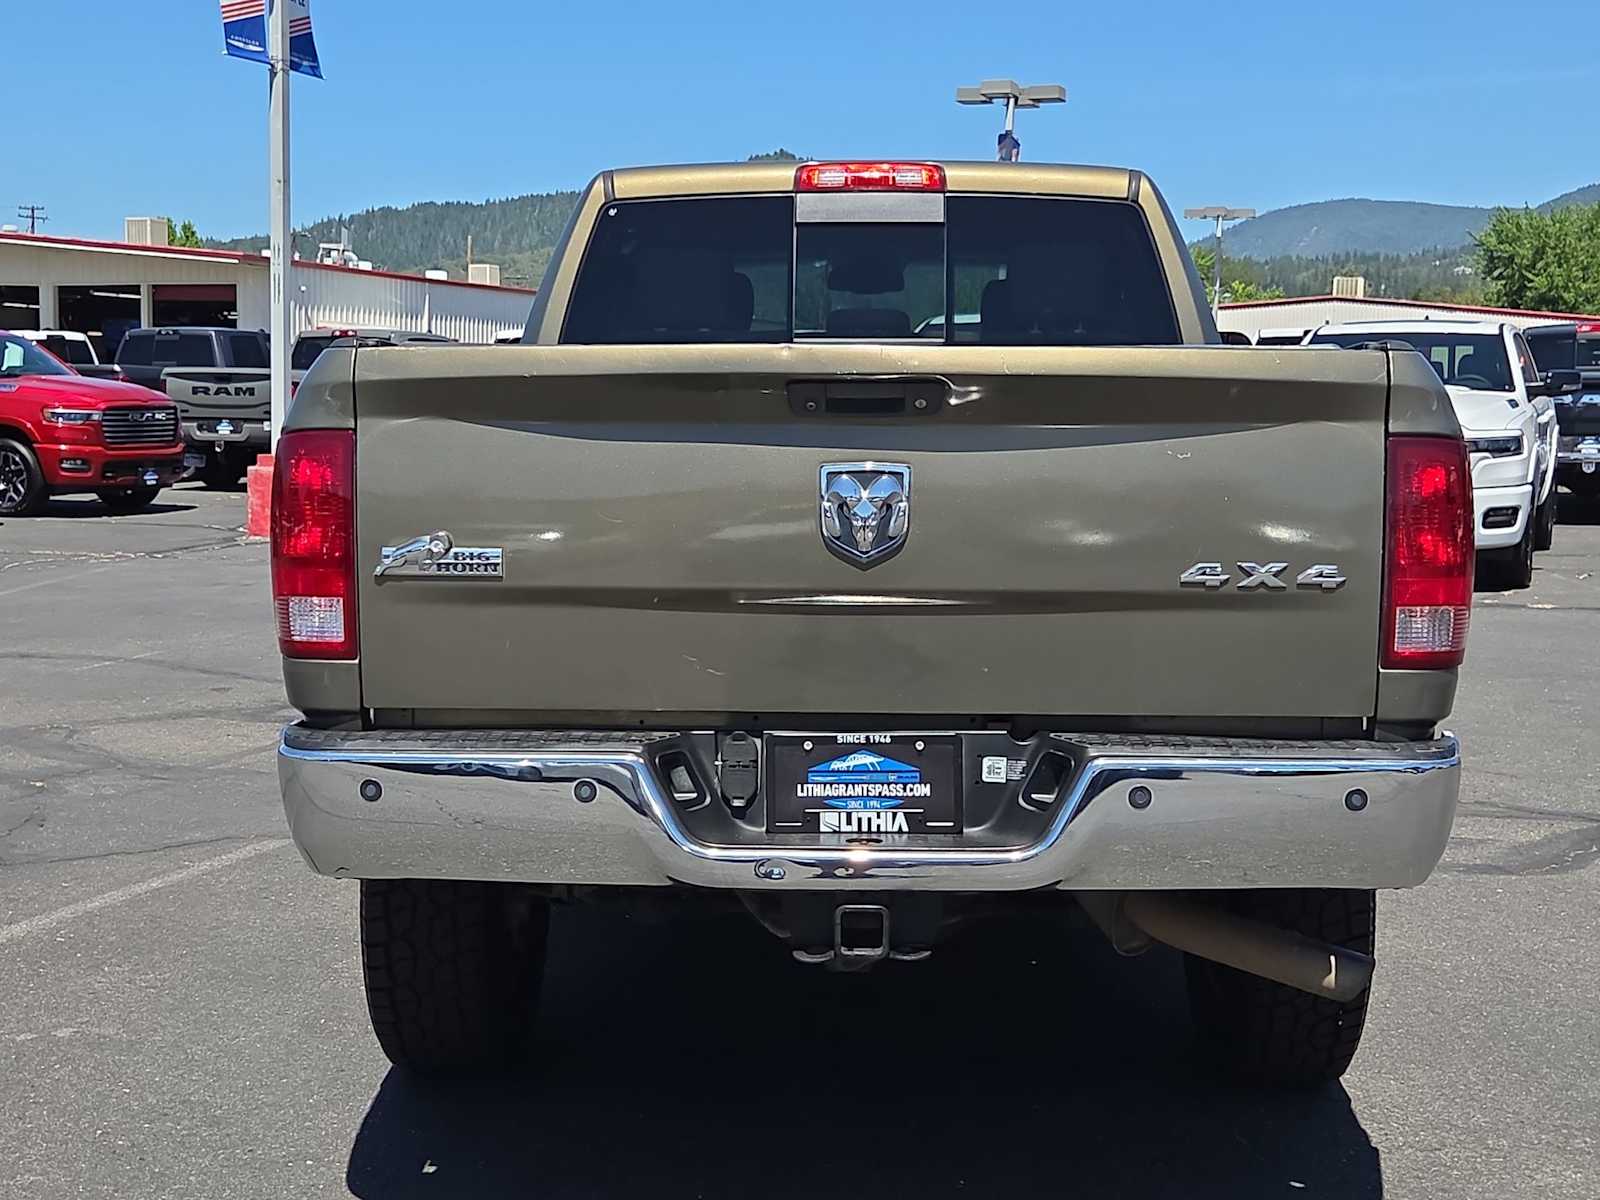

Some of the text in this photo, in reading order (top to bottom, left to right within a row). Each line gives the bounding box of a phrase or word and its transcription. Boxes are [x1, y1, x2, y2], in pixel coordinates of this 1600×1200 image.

[192, 386, 255, 396] RAM
[453, 552, 490, 561] BIG
[436, 562, 500, 573] HORN
[836, 734, 891, 744] SINCE 1946
[797, 783, 931, 798] LITHIAGRANTSPASS.COM
[840, 811, 909, 833] LITHIA
